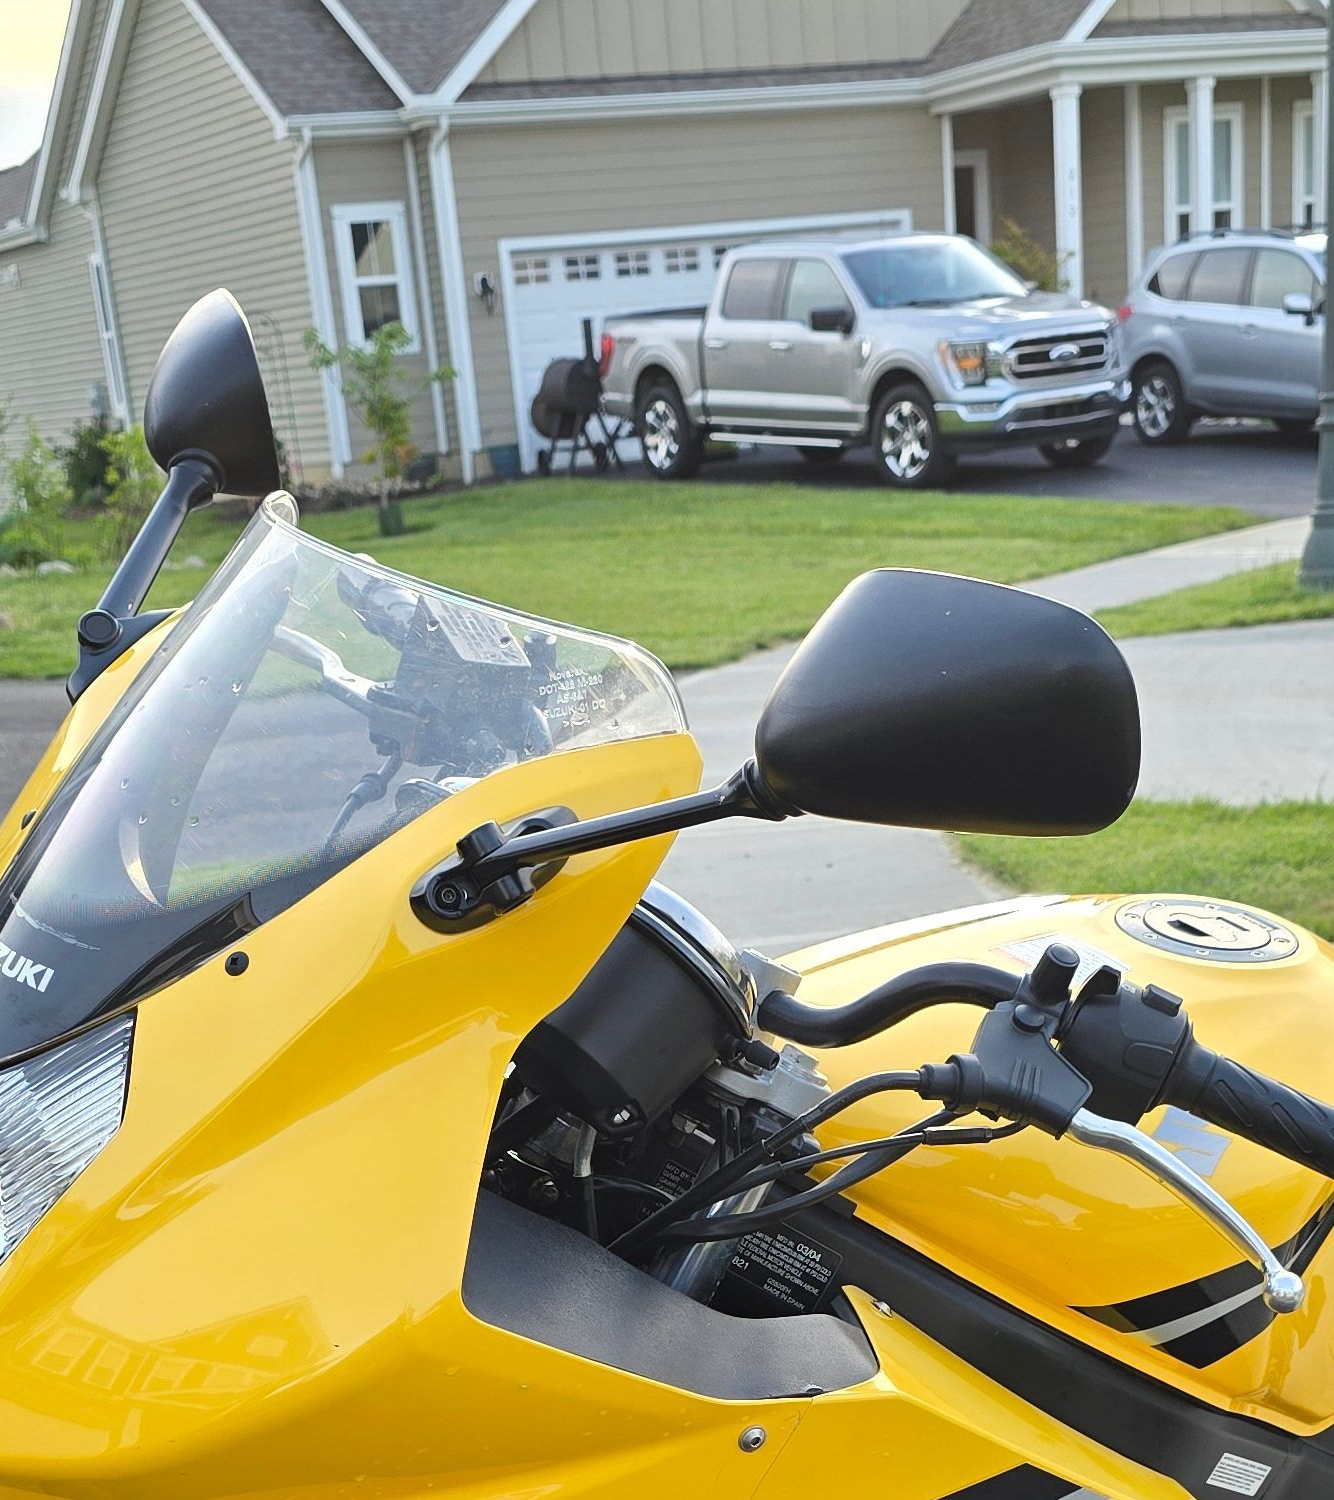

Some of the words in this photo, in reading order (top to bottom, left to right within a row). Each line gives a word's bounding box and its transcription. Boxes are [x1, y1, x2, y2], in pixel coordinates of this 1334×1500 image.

[794, 1242, 822, 1262] 03/04
[762, 1283, 780, 1297] MADE
[786, 1297, 805, 1310] SPAIN
